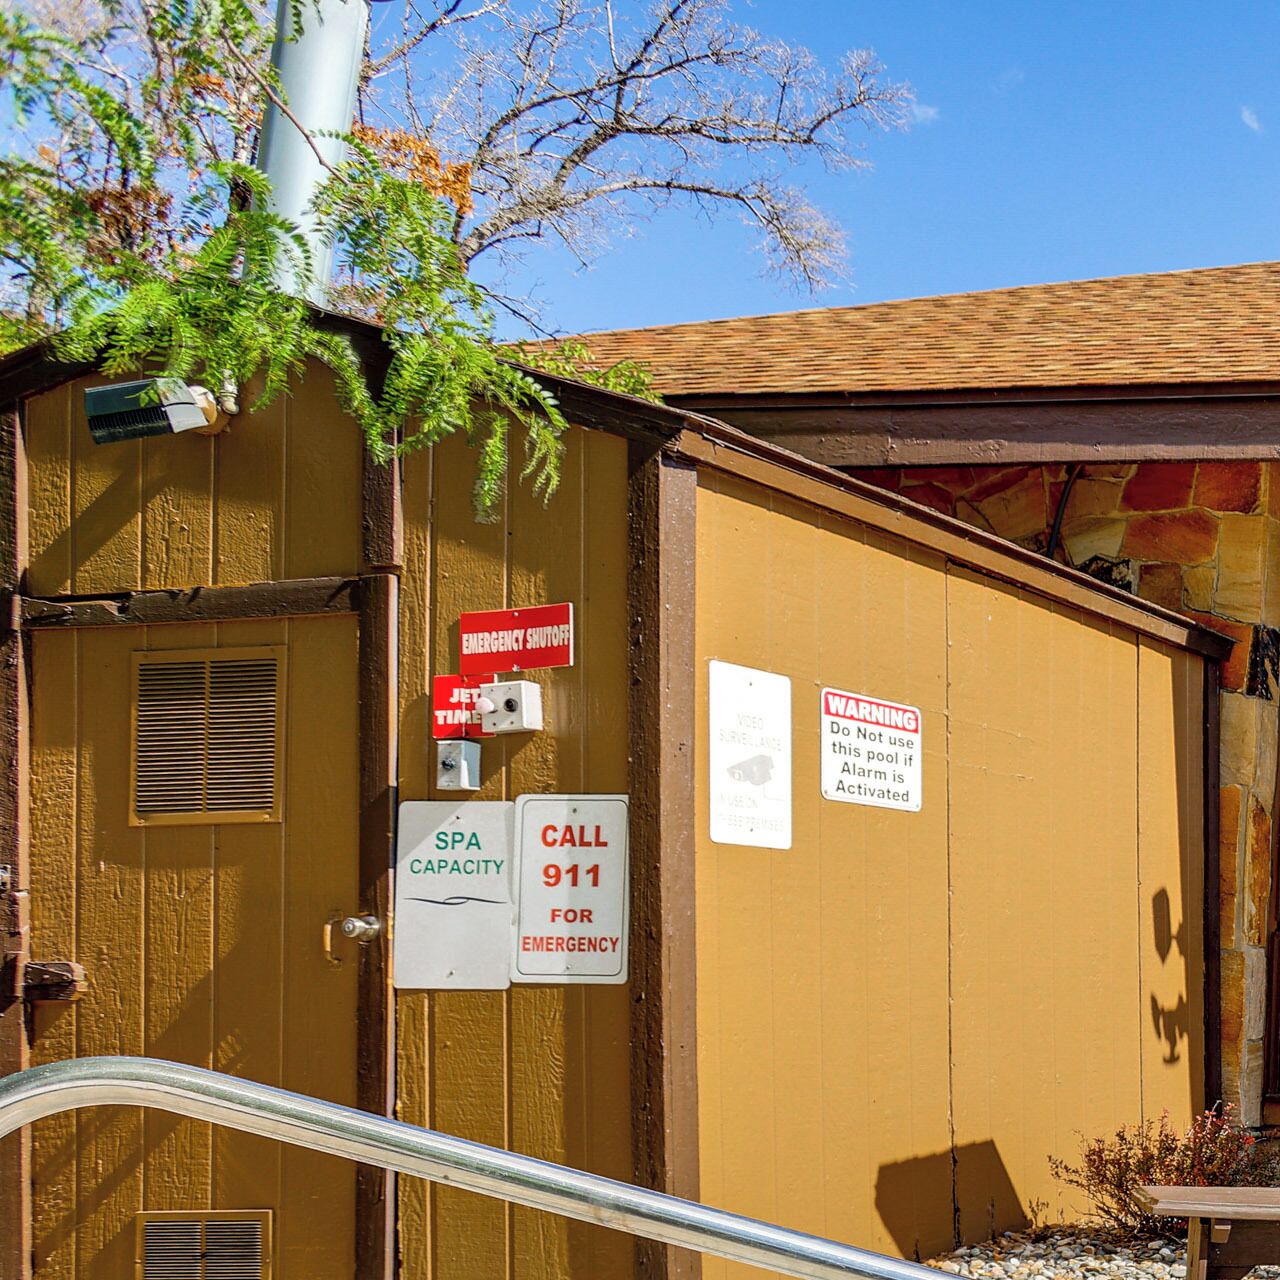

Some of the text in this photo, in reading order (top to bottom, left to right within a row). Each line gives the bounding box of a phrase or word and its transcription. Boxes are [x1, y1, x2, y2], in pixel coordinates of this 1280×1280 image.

[462, 624, 569, 655] EMERGENCY SHUTOFF
[449, 688, 481, 703] JET
[434, 710, 482, 725] TIME
[827, 694, 917, 731] WARNING
[830, 721, 914, 749] Do Not use
[832, 741, 913, 767] this pool if
[841, 762, 904, 784] Alarm is
[836, 780, 910, 802] Activated
[435, 831, 482, 851] SPA
[541, 824, 608, 848] CALL
[410, 859, 504, 875] CAPACITY
[542, 863, 600, 888] 911
[550, 908, 593, 923] FOR
[522, 936, 619, 953] EMERGENCY
